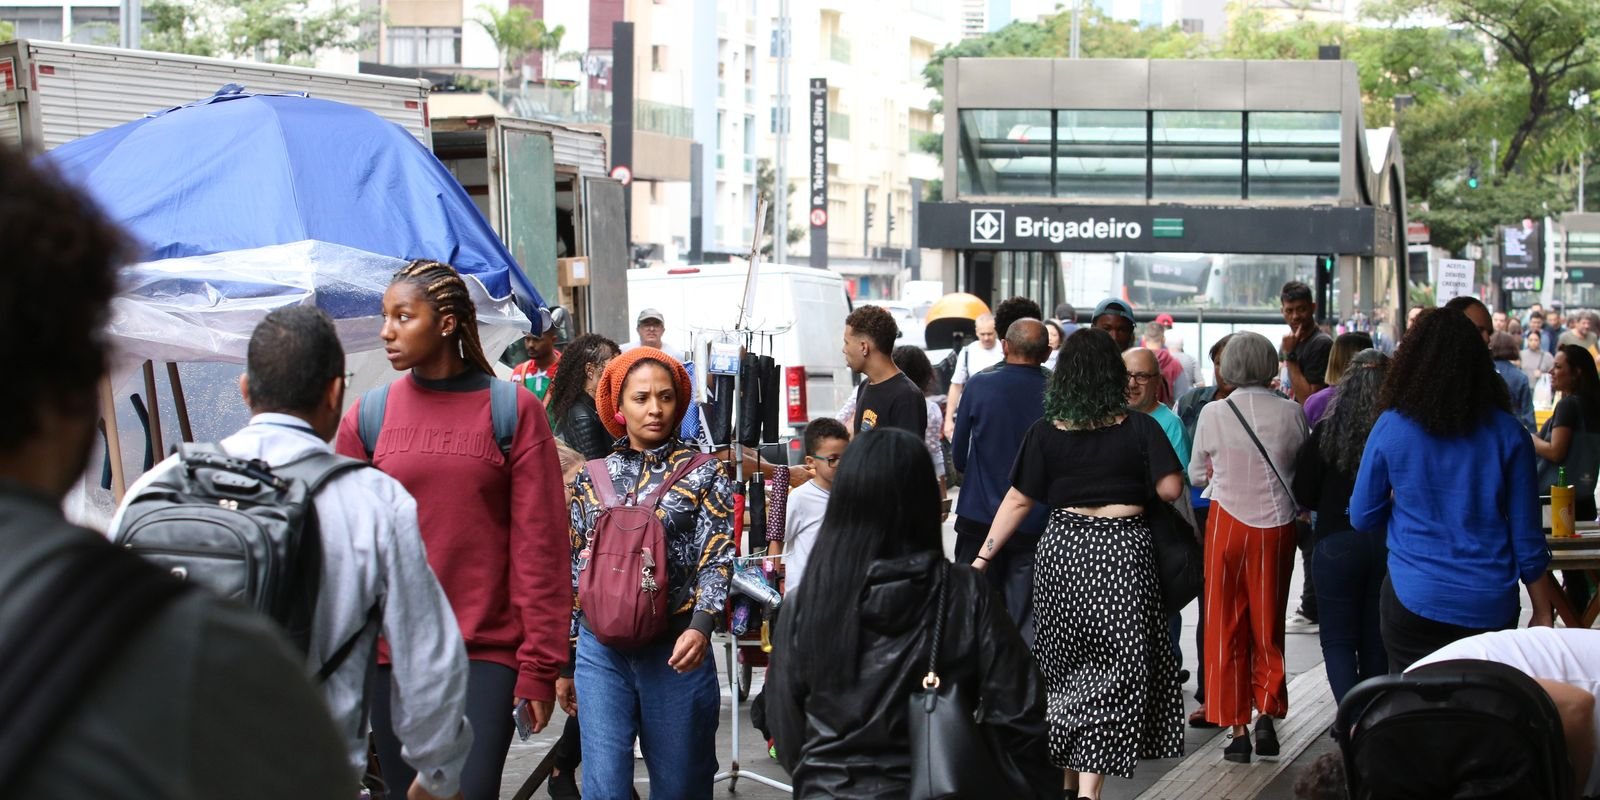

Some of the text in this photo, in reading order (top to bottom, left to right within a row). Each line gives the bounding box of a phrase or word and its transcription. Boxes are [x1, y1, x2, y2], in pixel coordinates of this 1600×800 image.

[813, 98, 825, 126] Silva
[813, 128, 825, 143] da
[813, 146, 825, 190] Teixeira
[813, 193, 825, 205] R.
[1015, 216, 1142, 243] Brigadeiro
[1505, 276, 1534, 289] 21°C
